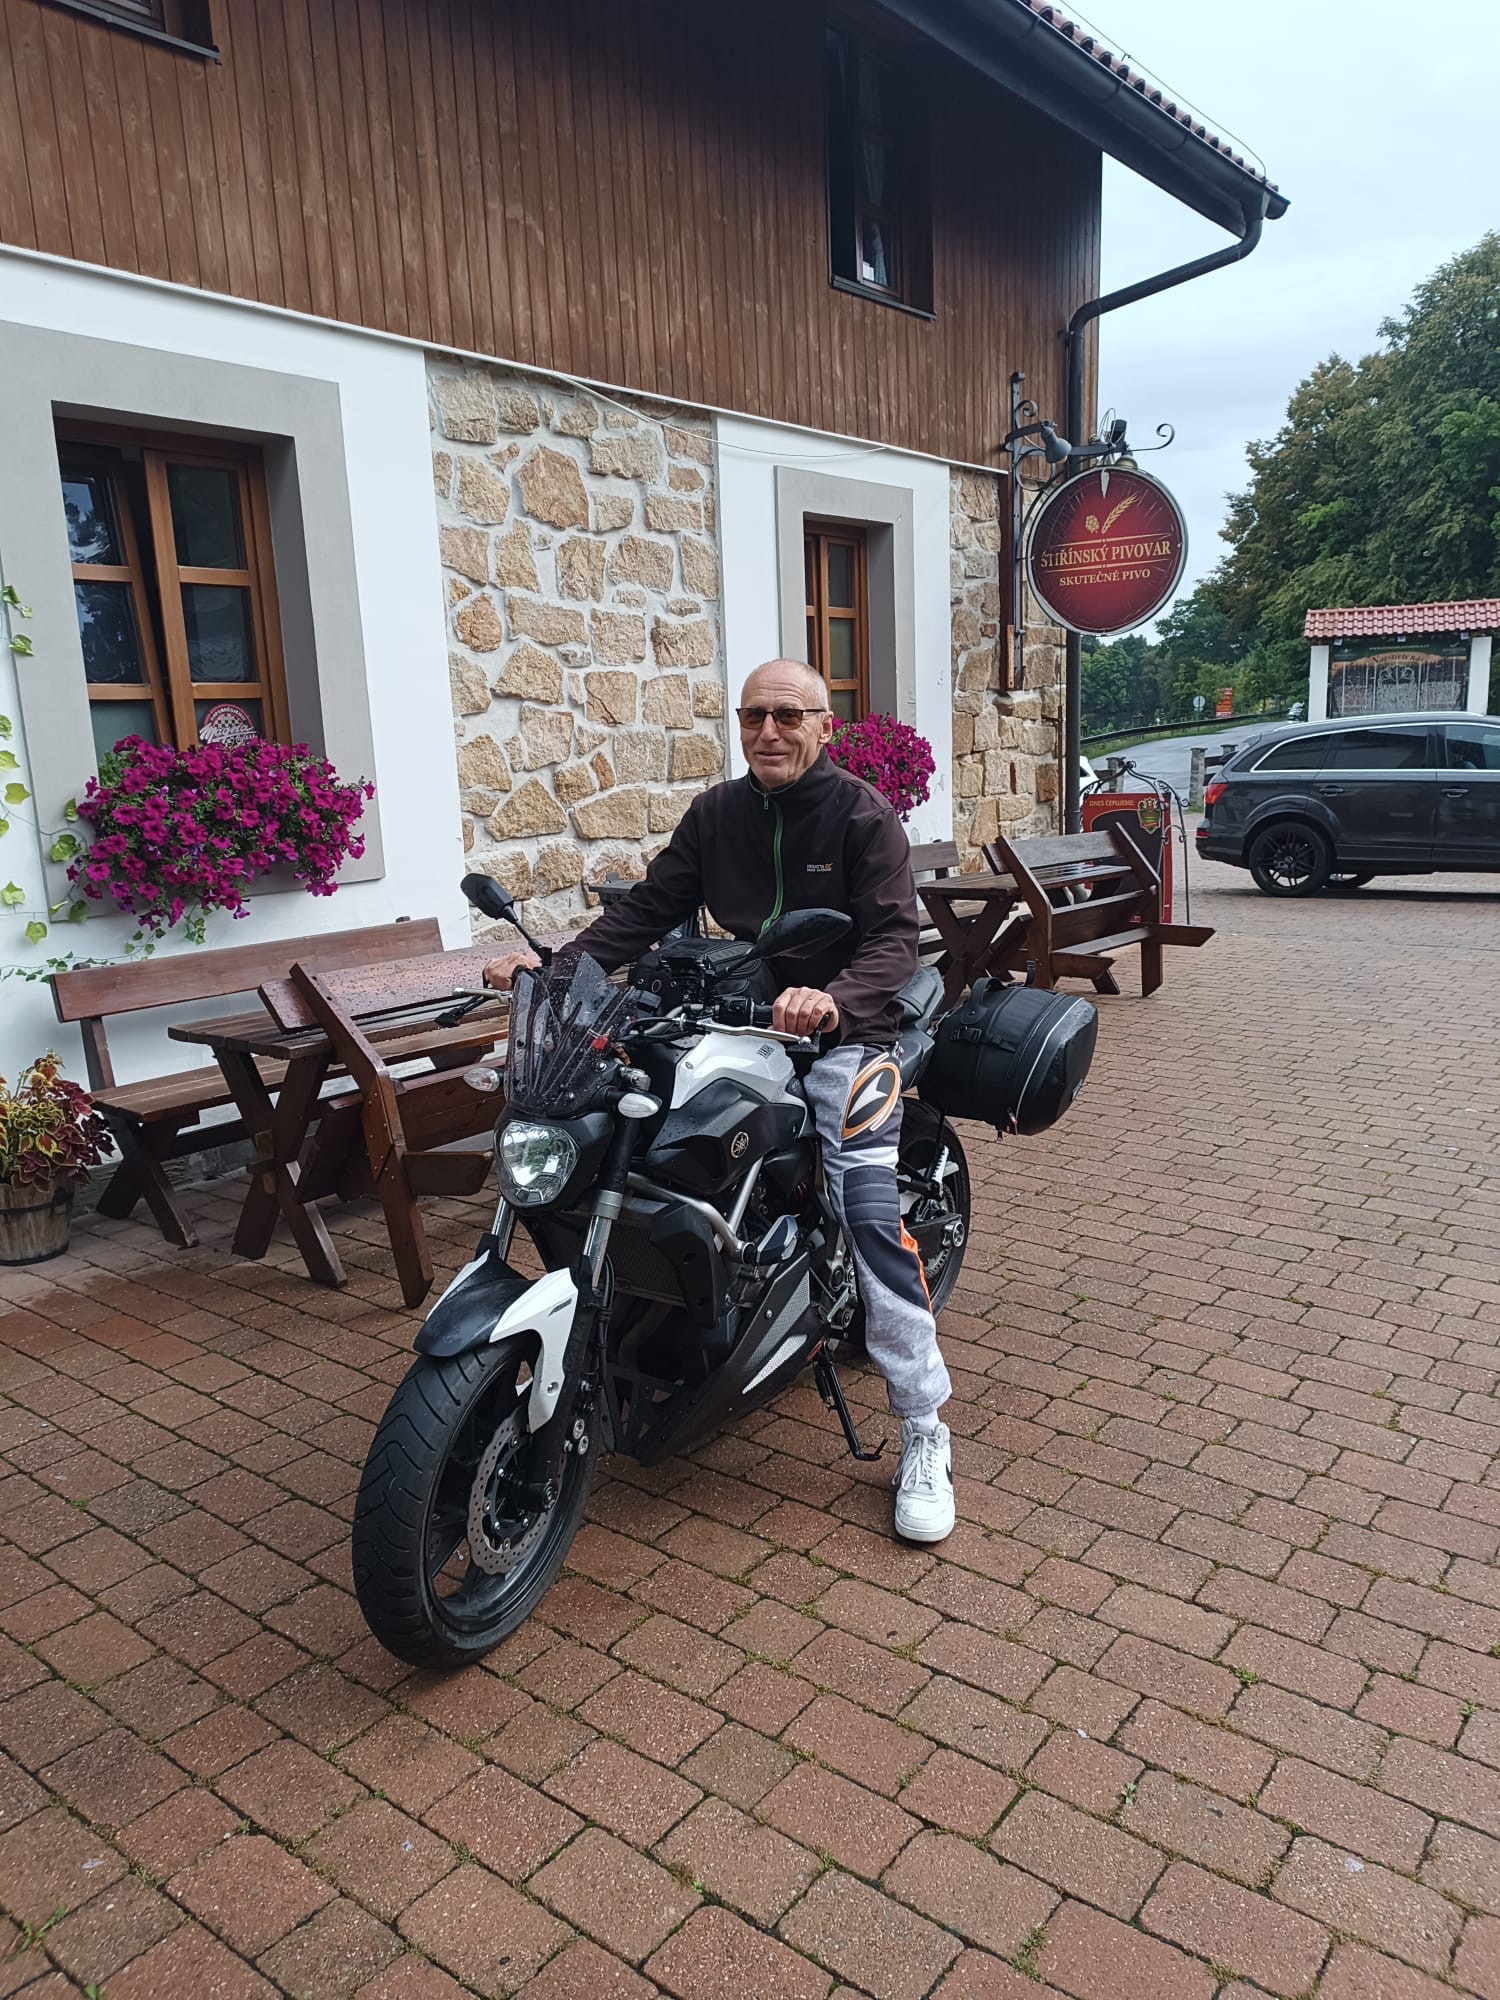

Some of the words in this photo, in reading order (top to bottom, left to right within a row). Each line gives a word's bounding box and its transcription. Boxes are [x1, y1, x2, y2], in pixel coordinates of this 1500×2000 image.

[1041, 544, 1109, 568] ŠTIŘÍNSKÝ
[1111, 541, 1171, 560] PIVOVAR
[1059, 570, 1120, 586] SKUTEČNÉ
[1122, 568, 1151, 580] PIVO
